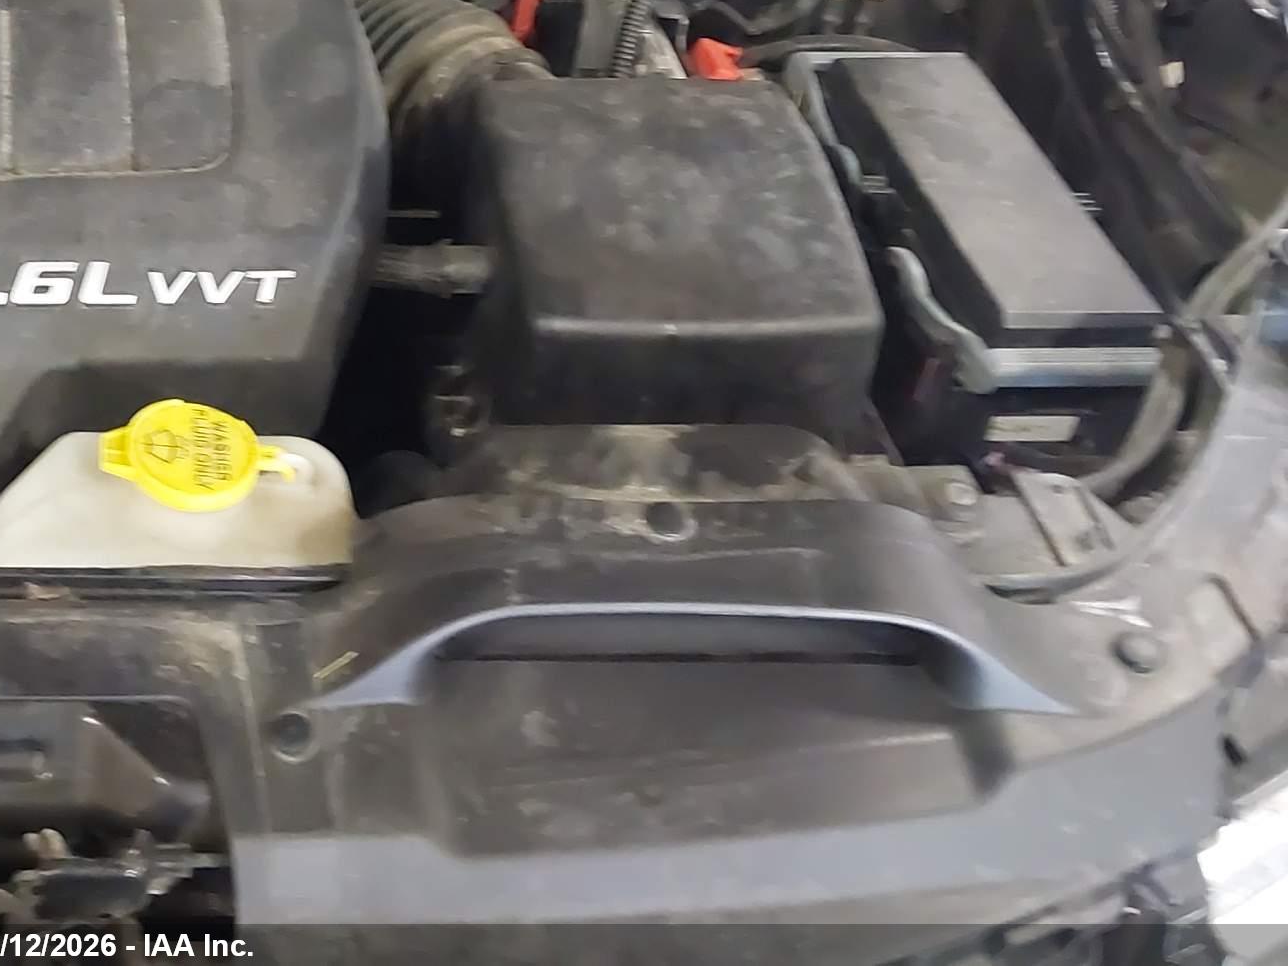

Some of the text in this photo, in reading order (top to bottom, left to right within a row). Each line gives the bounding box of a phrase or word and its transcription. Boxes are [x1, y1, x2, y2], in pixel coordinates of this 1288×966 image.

[146, 269, 297, 305] VVT
[192, 408, 216, 491] FLUID ONLY
[210, 420, 233, 481] WASHER
